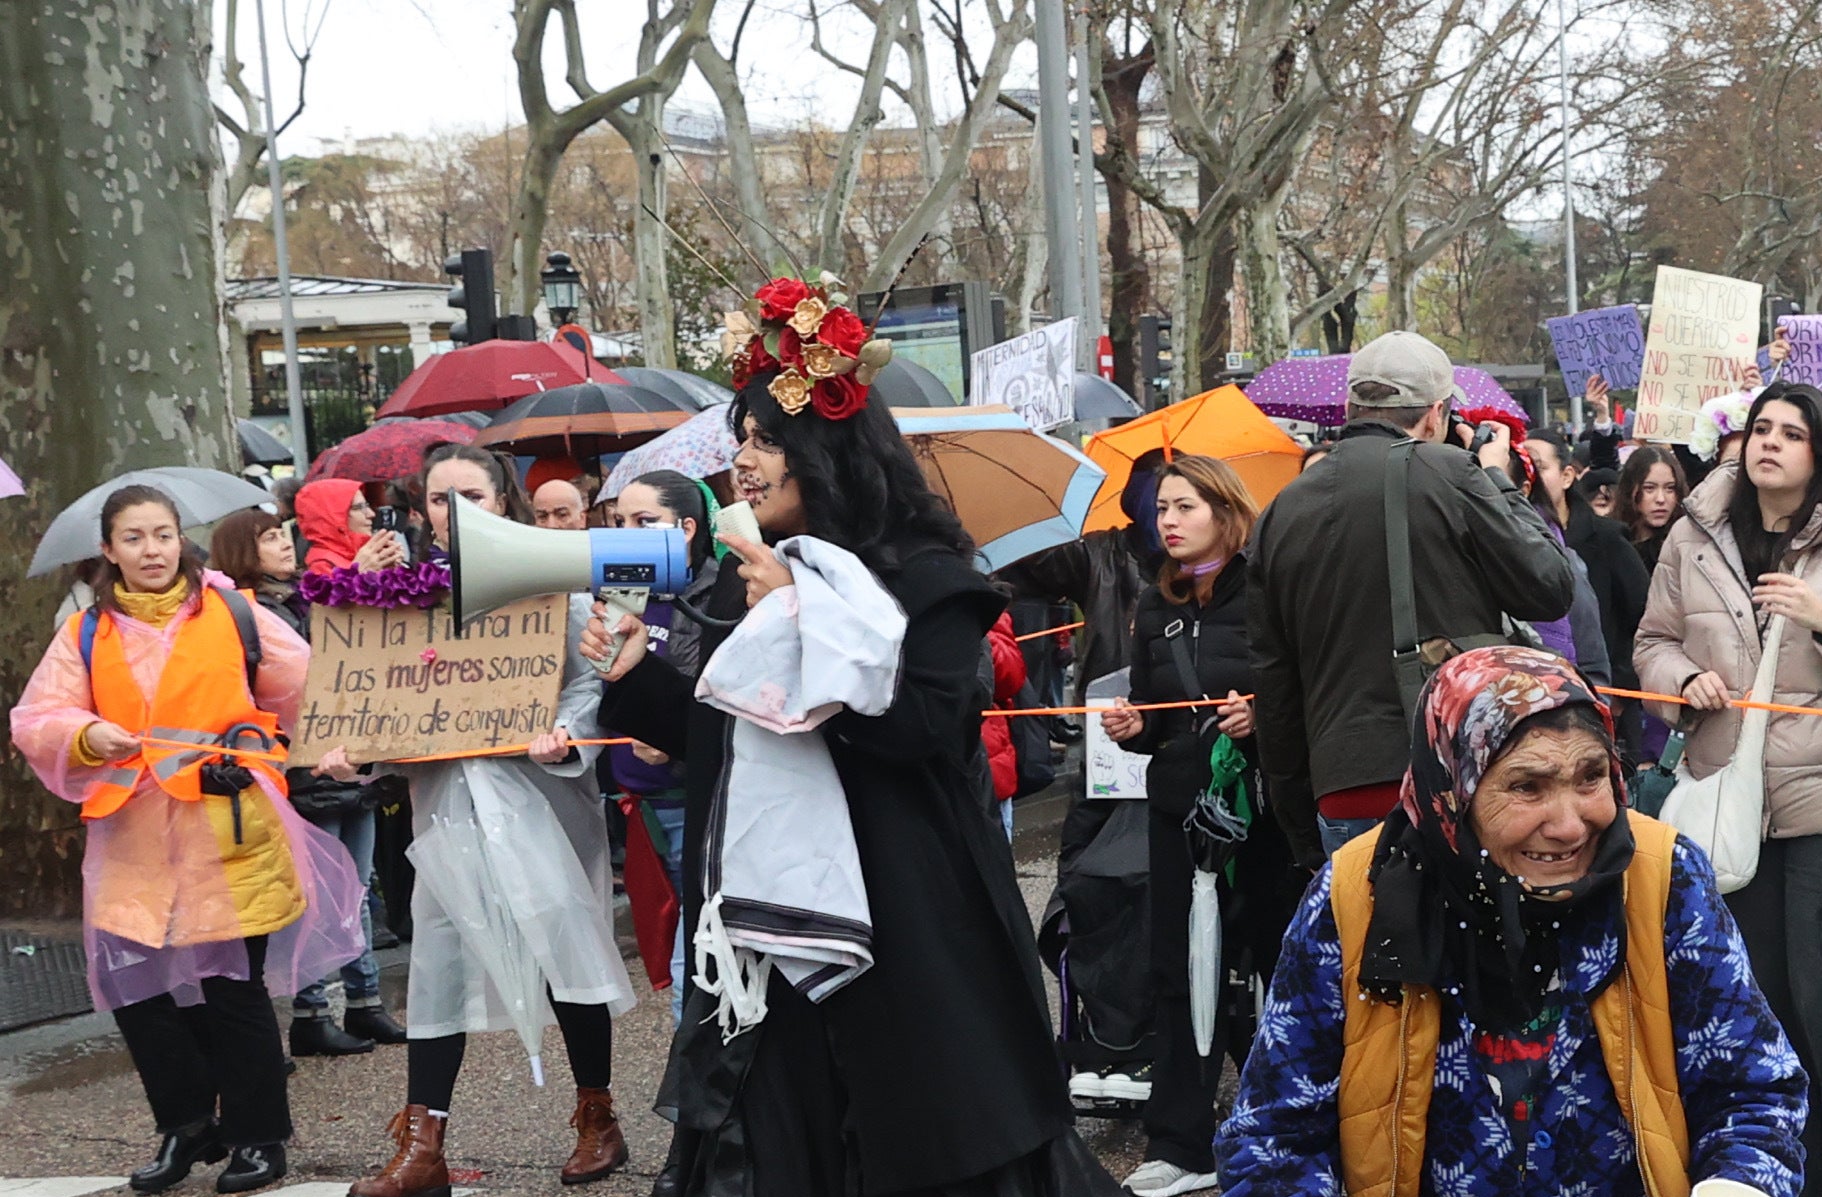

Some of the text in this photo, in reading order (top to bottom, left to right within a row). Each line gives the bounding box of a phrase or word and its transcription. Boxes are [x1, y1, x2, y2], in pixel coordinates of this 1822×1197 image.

[1662, 274, 1748, 322] NUESTROS
[1664, 313, 1730, 350] CUERPOS
[1646, 349, 1669, 377] NO
[1677, 353, 1697, 378] SE
[1789, 342, 1814, 364] OR
[1781, 364, 1814, 386] POR
[1640, 380, 1664, 406] NO
[1673, 383, 1690, 411] SE
[1636, 413, 1684, 439] NO SE
[322, 605, 551, 654] Ni la Tirra ni
[332, 652, 557, 694] las mujeres somos
[302, 697, 550, 748] territorio de conquista
